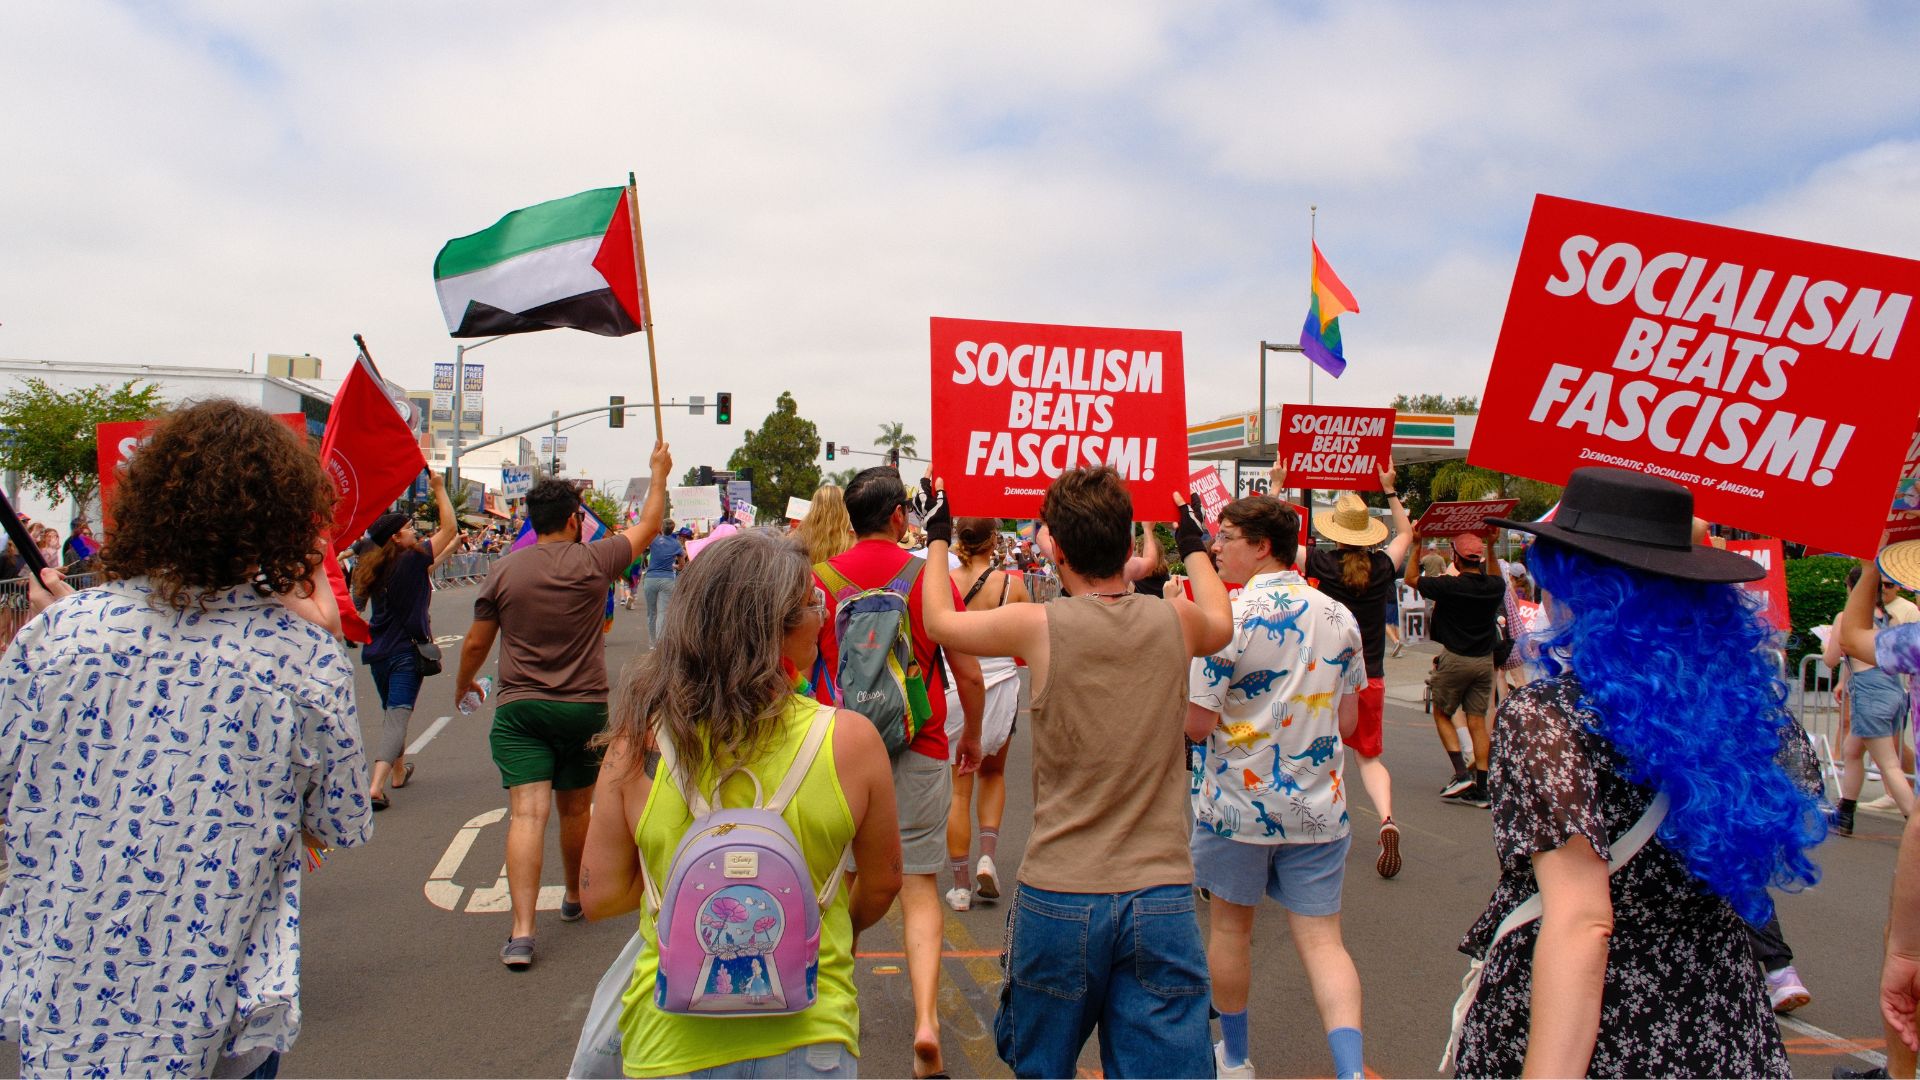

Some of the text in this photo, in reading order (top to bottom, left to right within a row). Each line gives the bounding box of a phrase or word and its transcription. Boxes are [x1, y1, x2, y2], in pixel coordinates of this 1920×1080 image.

[1545, 235, 1912, 360] SOCIALISM
[952, 341, 1162, 393] SOCIALISM
[1612, 317, 1799, 400] BEATS
[1008, 391, 1114, 432] BEATS
[1289, 414, 1386, 436] SOCIALISM
[1528, 363, 1856, 487] FASCISM!
[965, 431, 1157, 481] FASCISM!
[1290, 452, 1376, 474] FASCISM!
[1312, 435, 1360, 453] BEATS
[1004, 487, 1045, 496] DEMOCRATIC
[1579, 448, 1765, 499] DEMOCRATIC SOCIALISTS OF AMERICA
[1431, 504, 1509, 515] SOCIALISM
[1444, 514, 1483, 522] BEATS
